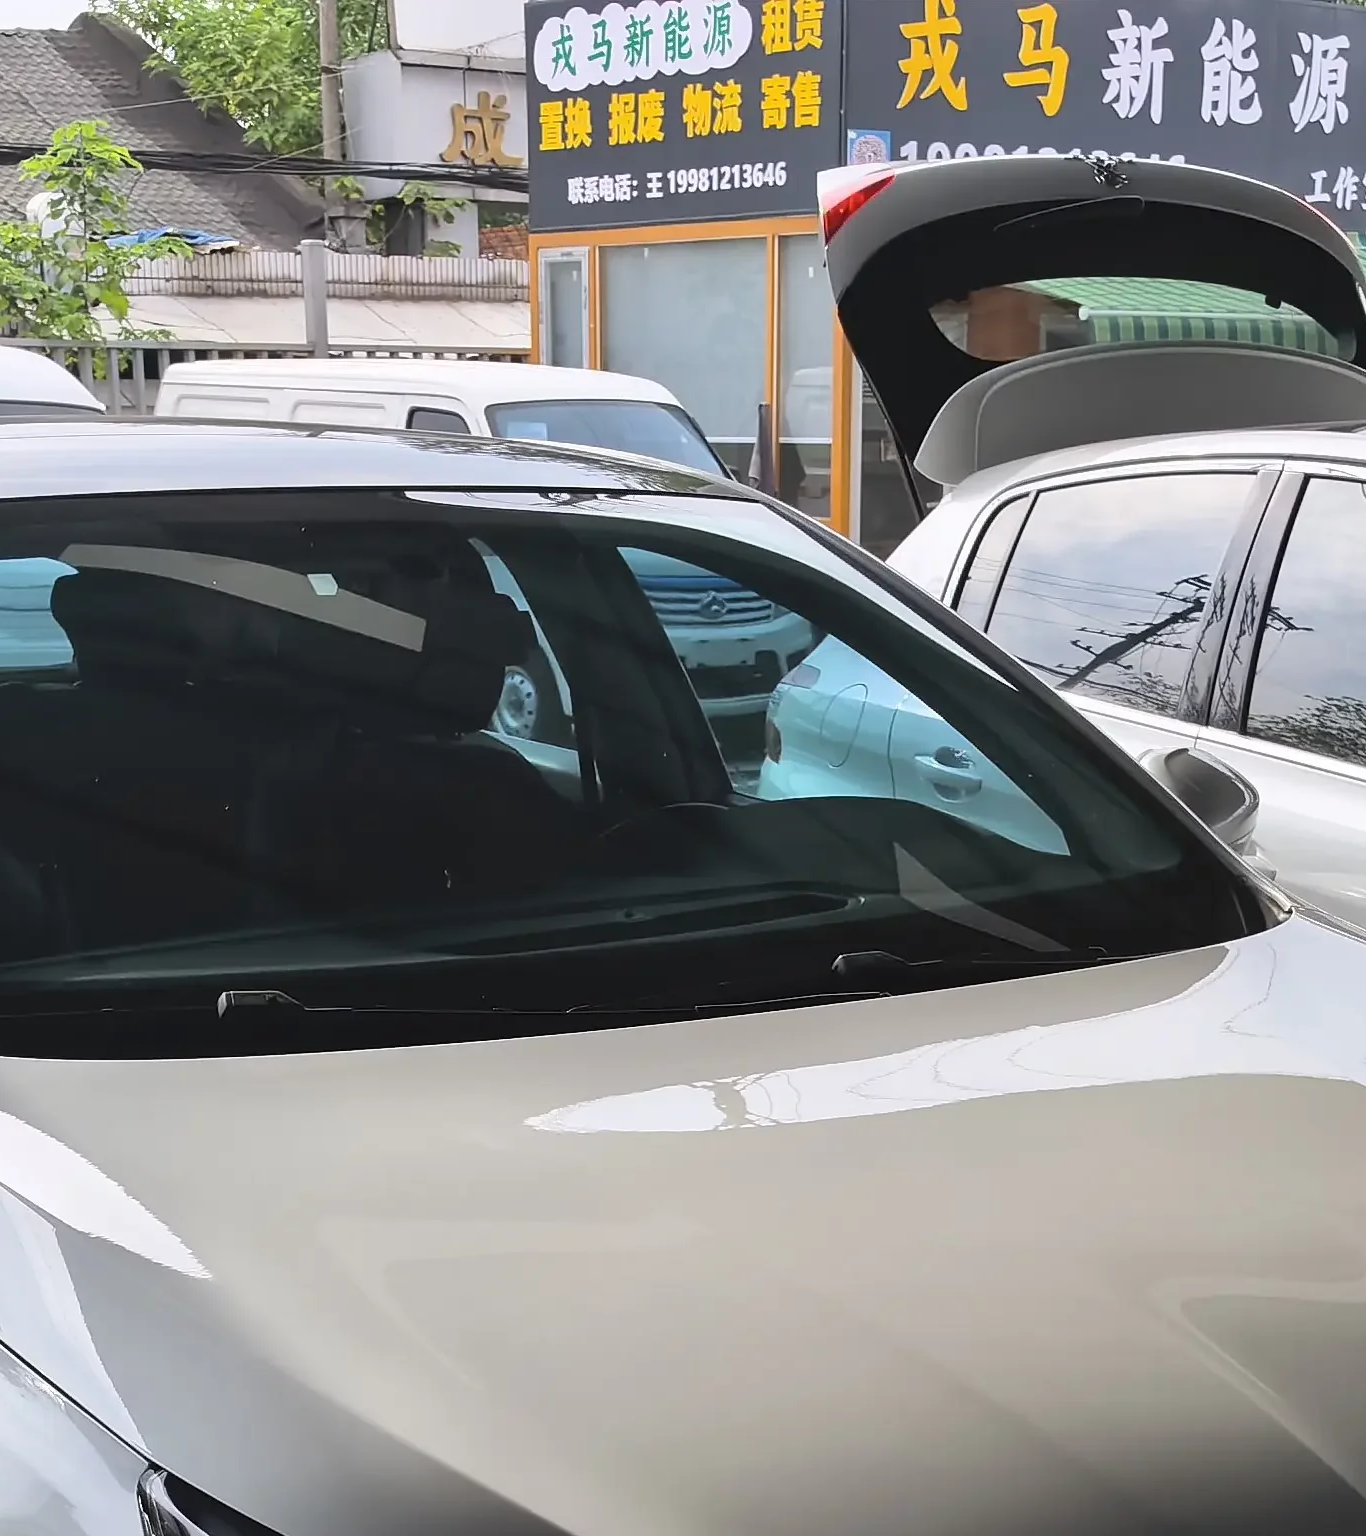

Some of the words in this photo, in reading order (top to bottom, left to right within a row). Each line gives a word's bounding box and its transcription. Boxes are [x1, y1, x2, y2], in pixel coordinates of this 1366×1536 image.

[550, 2, 733, 80] 戎马新能源
[761, 0, 824, 54] 租赁
[896, 0, 1351, 133] 戎马新能源
[439, 91, 525, 167] 成
[539, 97, 592, 151] 置换
[608, 89, 665, 146] 报废
[682, 81, 742, 138] 物流
[760, 70, 822, 130] 寄售
[667, 161, 787, 195] 19981213646
